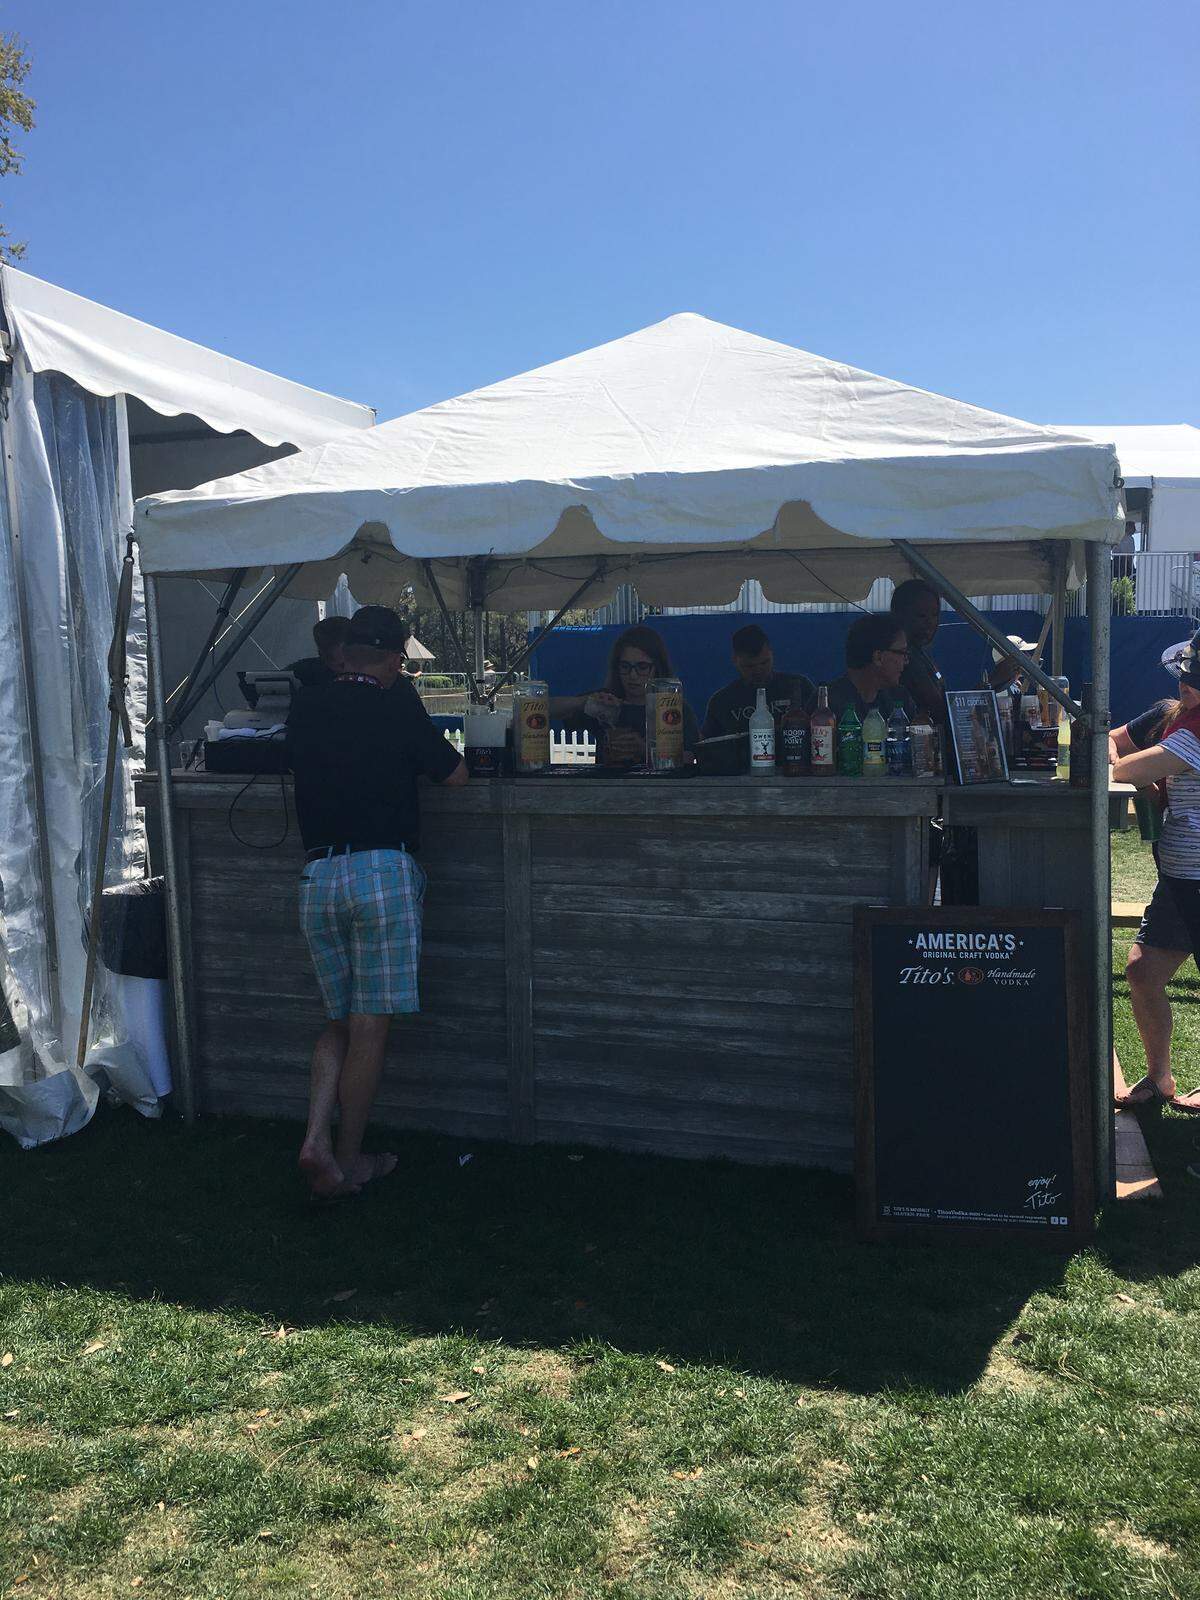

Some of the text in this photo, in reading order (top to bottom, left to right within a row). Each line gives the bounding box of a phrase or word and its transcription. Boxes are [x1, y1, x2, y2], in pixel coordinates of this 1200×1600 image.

[915, 933, 1016, 951] AMERICA'S
[922, 951, 957, 959] ORIGINAL
[899, 965, 955, 985] Tito's
[986, 967, 1036, 979] Handmade
[1027, 1174, 1057, 1190] enjoy!
